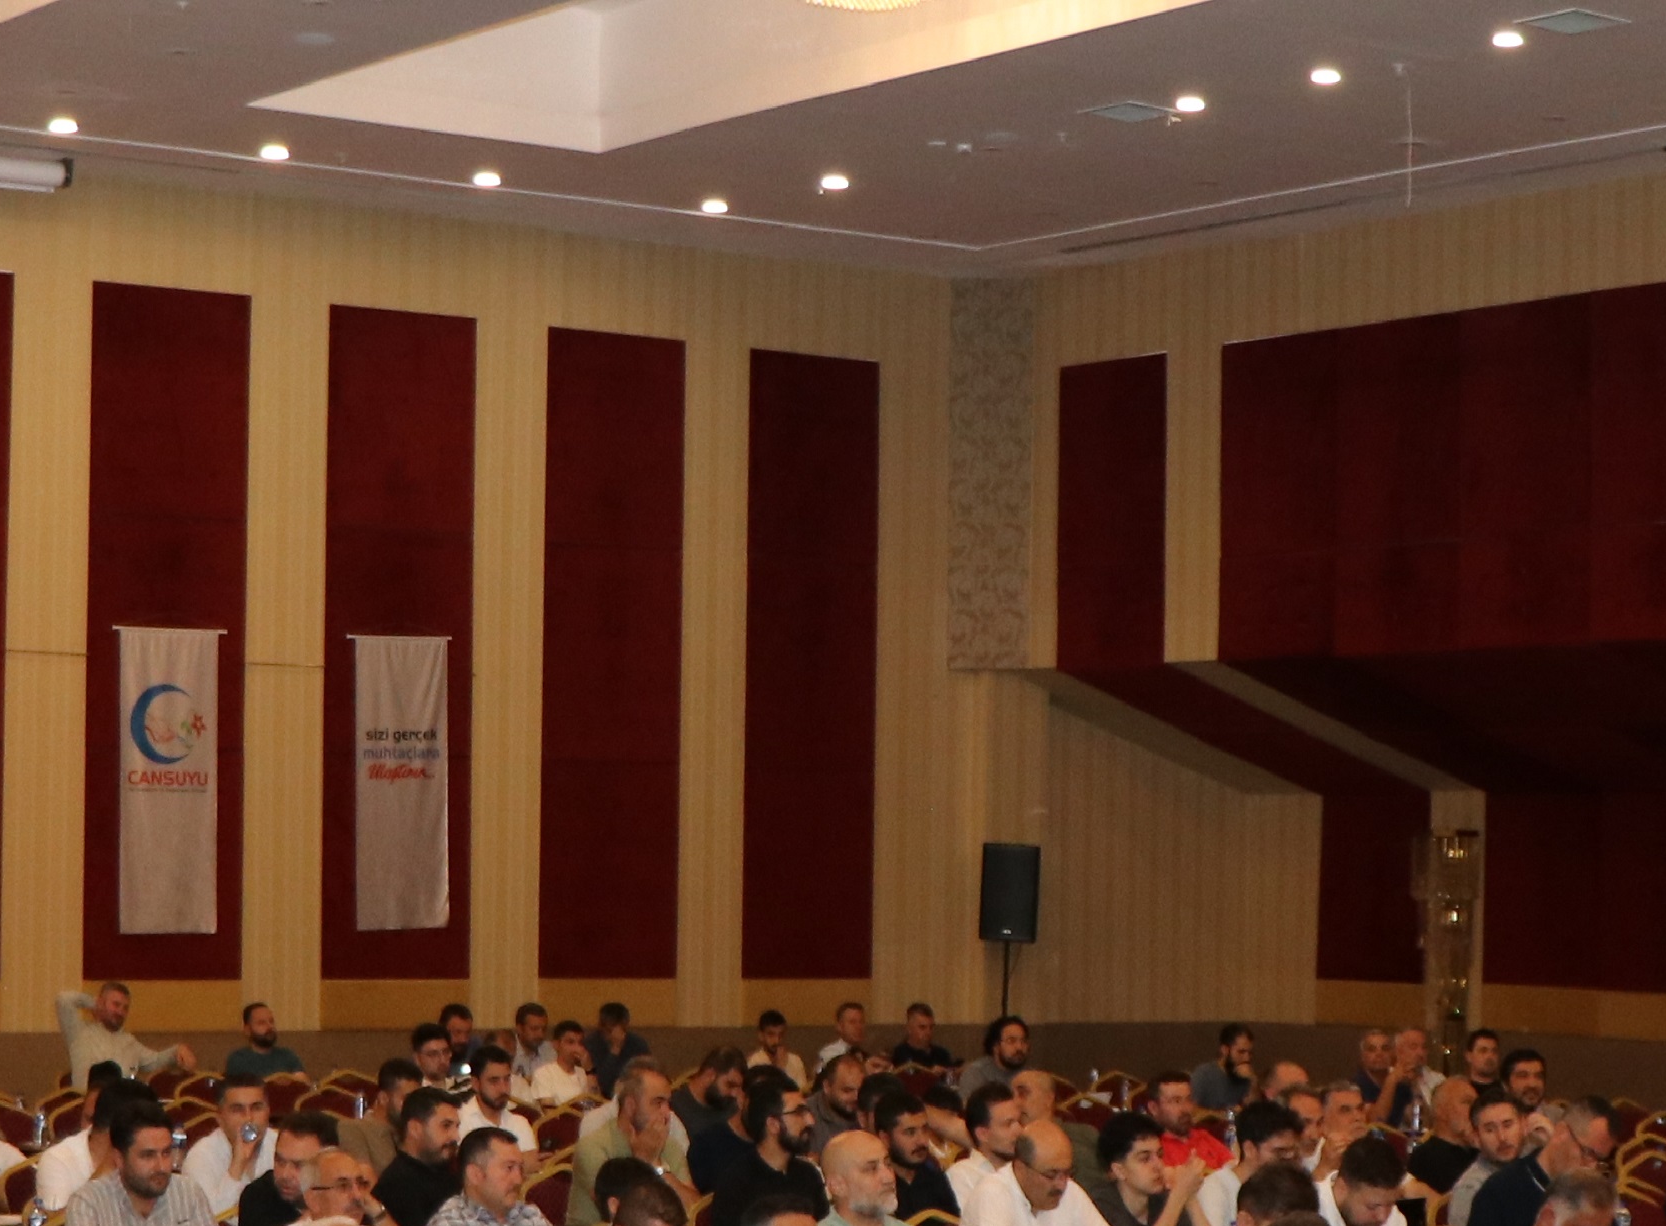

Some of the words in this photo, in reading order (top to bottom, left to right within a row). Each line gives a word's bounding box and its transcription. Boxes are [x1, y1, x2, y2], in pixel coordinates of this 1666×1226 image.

[366, 728, 389, 741] sizi
[393, 729, 437, 743] gerçek
[128, 770, 208, 786] CANSUYU
